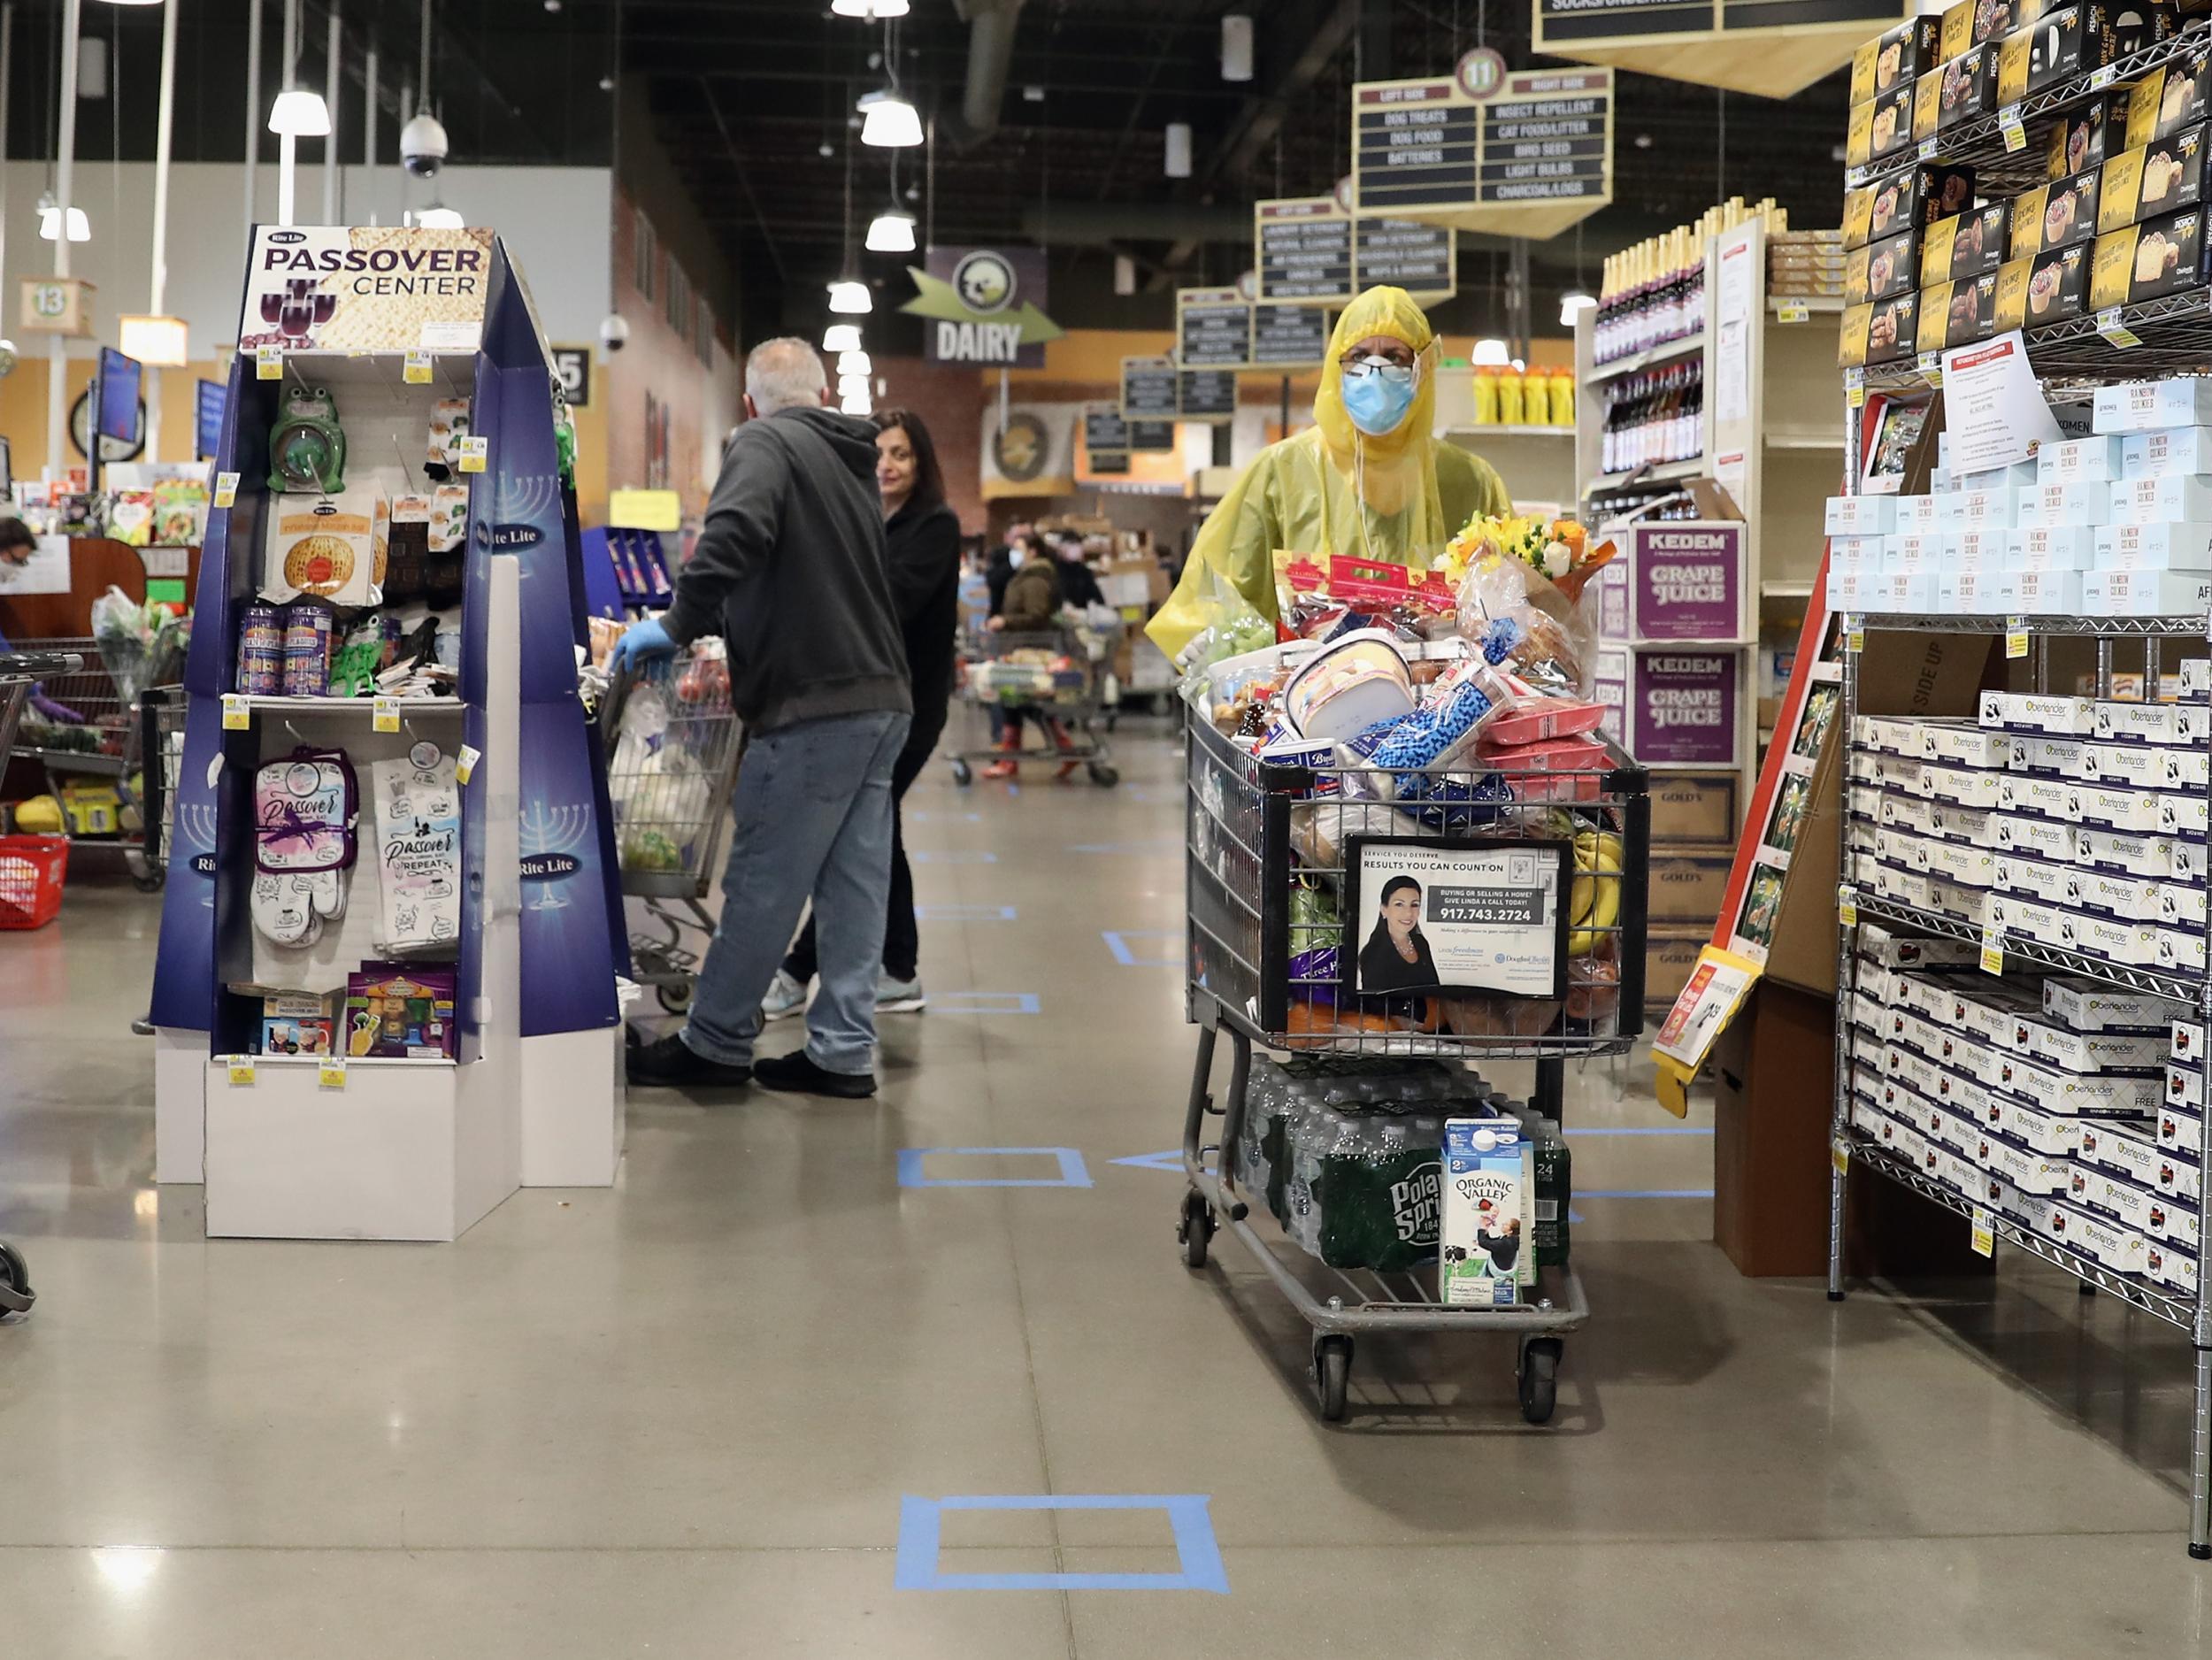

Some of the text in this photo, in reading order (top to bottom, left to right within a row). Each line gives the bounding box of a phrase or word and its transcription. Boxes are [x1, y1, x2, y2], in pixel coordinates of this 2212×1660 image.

[1466, 60, 1492, 87] 11
[1532, 77, 1586, 92] RIGHT SIDE
[1379, 91, 1402, 102] LEFT
[1495, 99, 1595, 119] INSECT REPELLENT
[1384, 110, 1448, 126] DOG TREATS
[1389, 129, 1444, 145] DOG FOOD
[1387, 150, 1443, 165] BATTERIES
[1515, 142, 1571, 158] BIRD SEED
[1505, 162, 1574, 178] LIGHT BULBS
[271, 234, 304, 242] Rite Lite
[264, 248, 481, 273] PASSOVER
[353, 276, 476, 296] CENTER
[36, 285, 65, 313] 13
[936, 321, 1023, 362] DAIRY
[510, 531, 536, 542] Lite
[1648, 534, 1725, 550] KEDEM
[1649, 565, 1724, 583] GRAPE
[1652, 584, 1725, 607] JUICE
[1647, 658, 1722, 672] KEDEM
[1913, 641, 1944, 705] SIDE UP
[1647, 689, 1722, 706] GRAPE
[2026, 701, 2066, 714] Oberlander
[1649, 708, 1722, 729] JUICE
[2131, 710, 2163, 723] Oberlander
[2046, 744, 2079, 757] Oberlander
[2116, 753, 2147, 766] Oberlander
[2099, 795, 2131, 810] Oberlander
[384, 834, 450, 868] Passover
[2113, 840, 2144, 854] Oberlander
[403, 859, 442, 870] REPEAT
[519, 859, 573, 875] Rite Lite
[1363, 861, 1404, 870] RESULTS
[1407, 862, 1427, 871] YOU
[1453, 863, 1486, 872] COUNT
[1440, 908, 1531, 921] 917.743.2724
[2089, 1000, 2140, 1011] Oberlander
[2088, 1041, 2137, 1052] Oberlander
[2066, 1083, 2115, 1094] Oberlander
[2056, 1125, 2078, 1134] Oberl
[1452, 1160, 1461, 1170] 2
[1537, 1164, 1553, 1175] 24
[1455, 1178, 1514, 1193] ORGANIC
[1462, 1189, 1507, 1201] VALLEY
